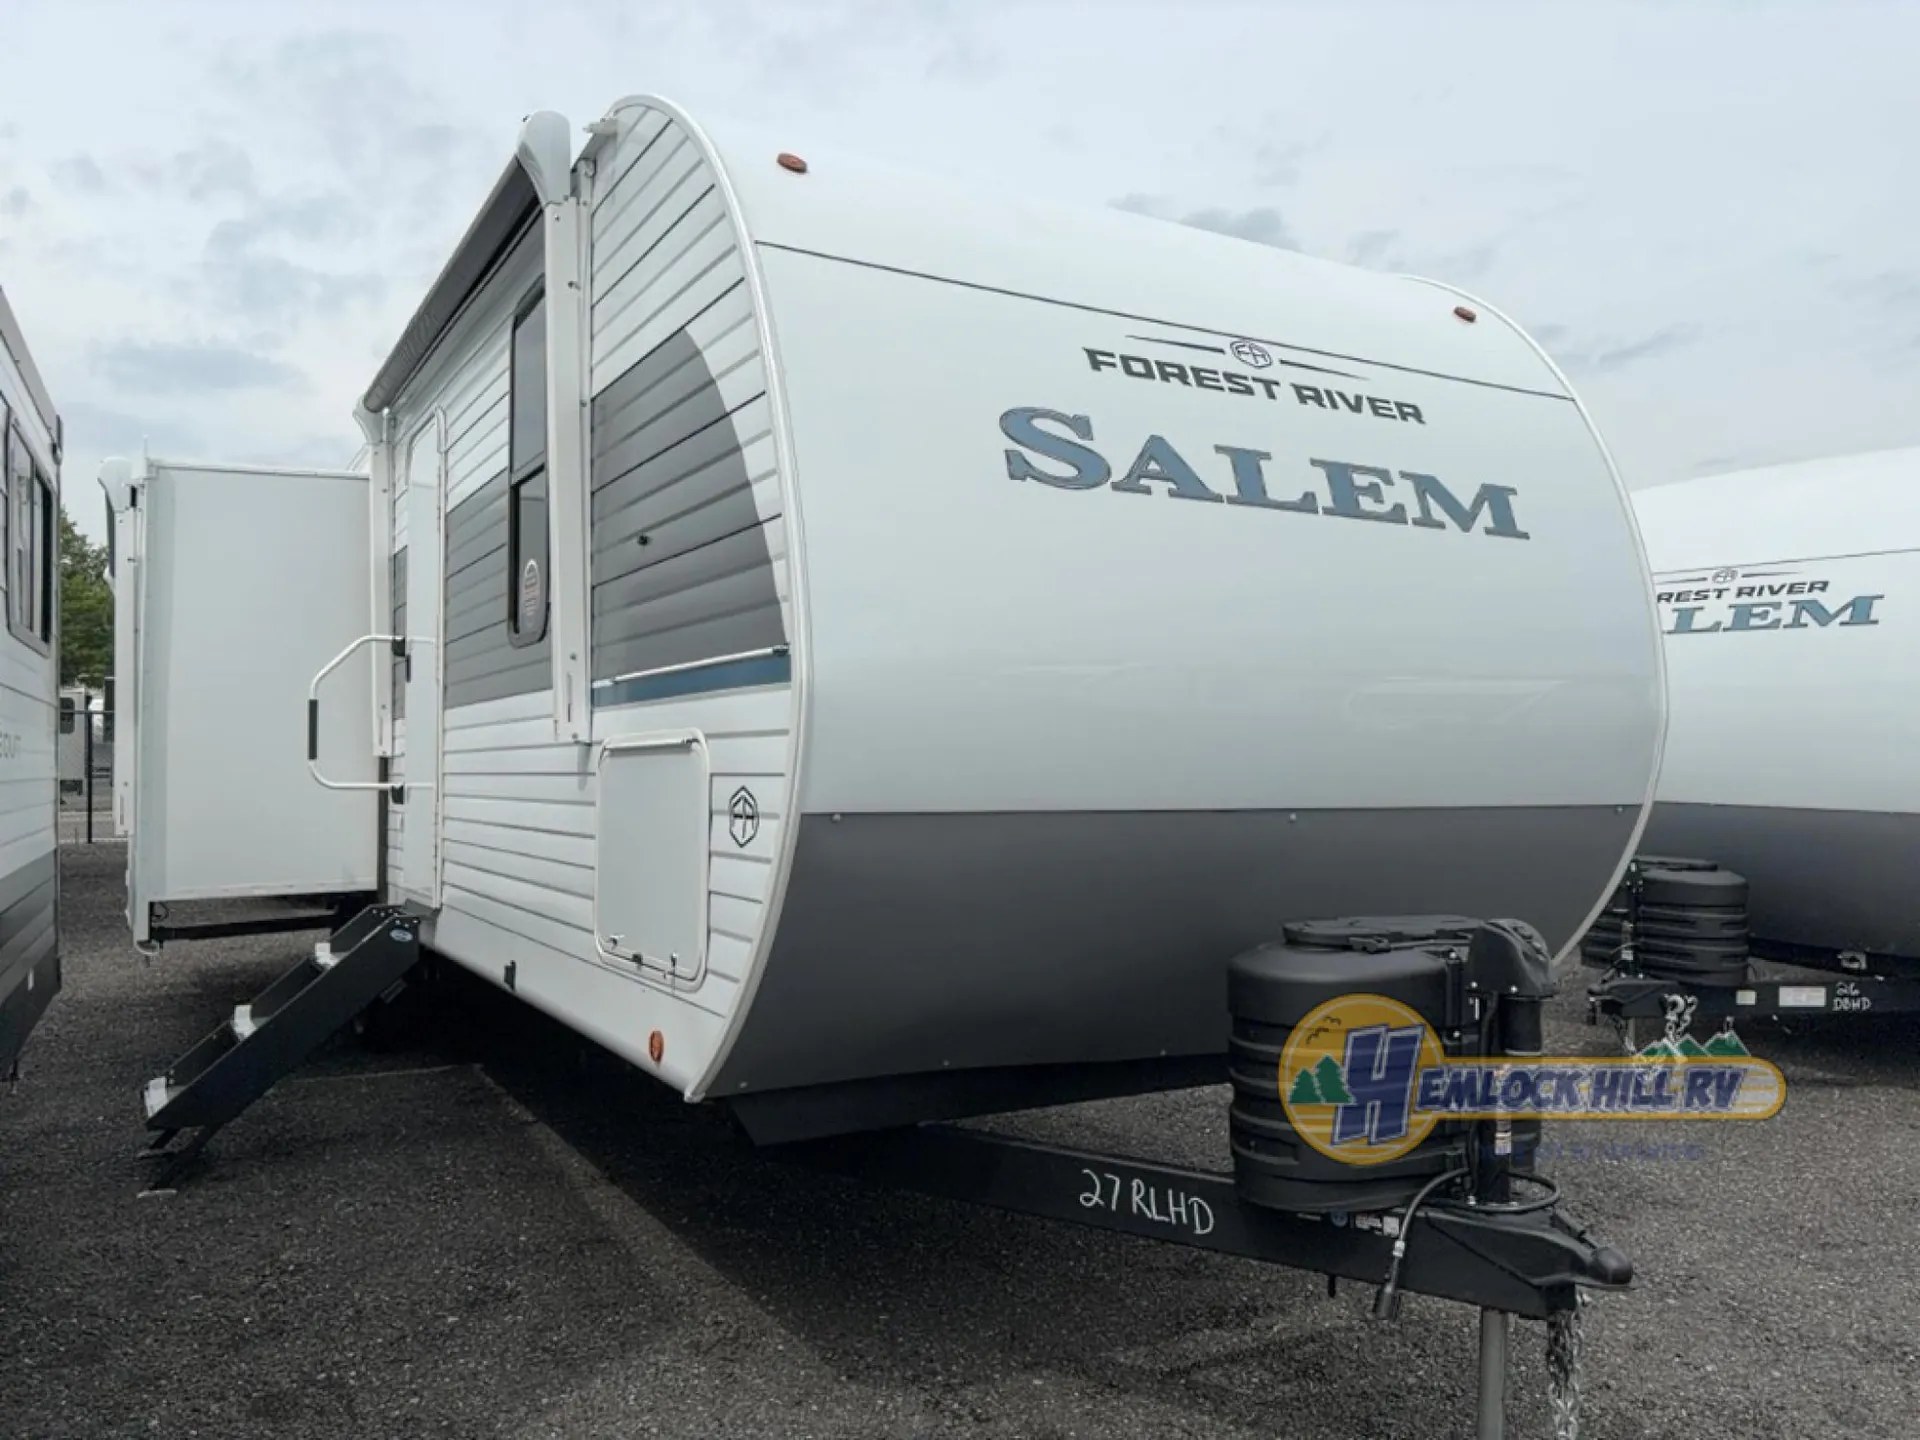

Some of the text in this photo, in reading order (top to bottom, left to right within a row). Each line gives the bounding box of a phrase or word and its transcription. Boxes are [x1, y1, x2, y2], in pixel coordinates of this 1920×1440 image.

[1082, 347, 1427, 425] FOREST RIVER
[999, 405, 1531, 541] SALEM
[1663, 594, 1885, 635] LEM
[1735, 580, 1830, 600] RIVER
